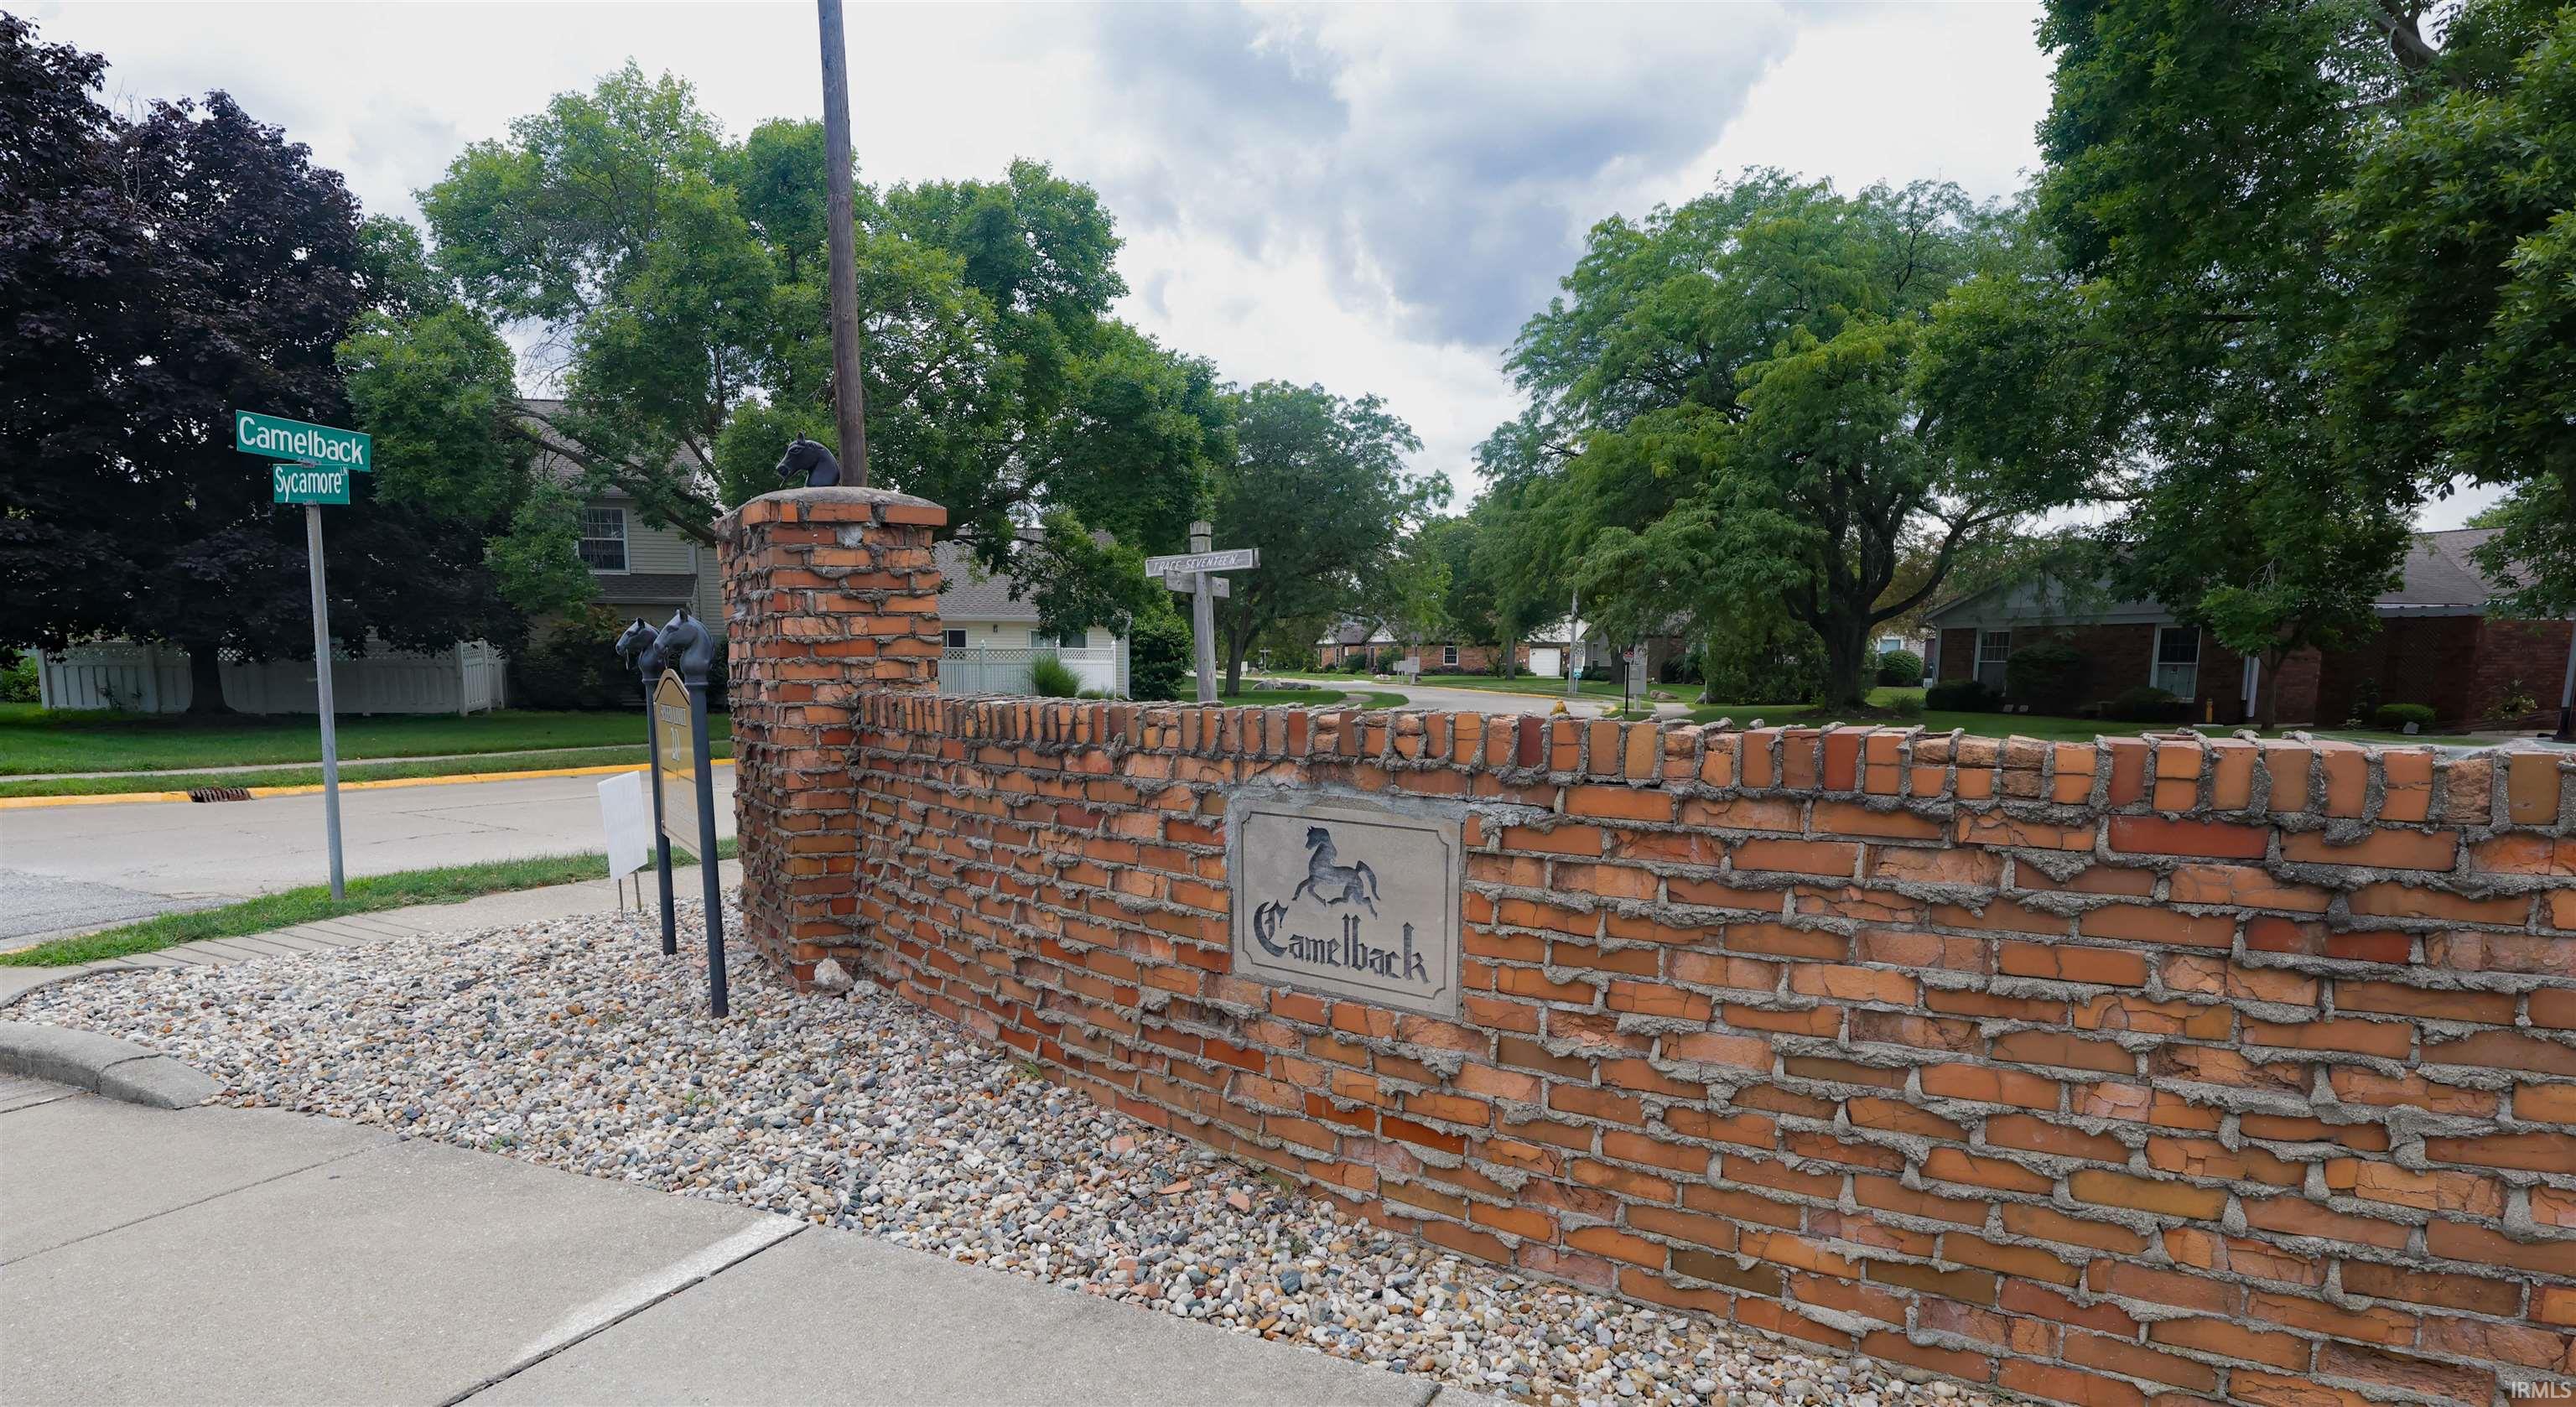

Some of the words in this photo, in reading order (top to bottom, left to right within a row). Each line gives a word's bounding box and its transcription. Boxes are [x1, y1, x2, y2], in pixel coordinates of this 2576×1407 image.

[239, 416, 364, 465] Camelback
[275, 466, 342, 502] Sycamore
[1153, 560, 1181, 571] TRACE
[1186, 553, 1239, 569] SEVENTEEN
[1254, 899, 1431, 984] Camelback
